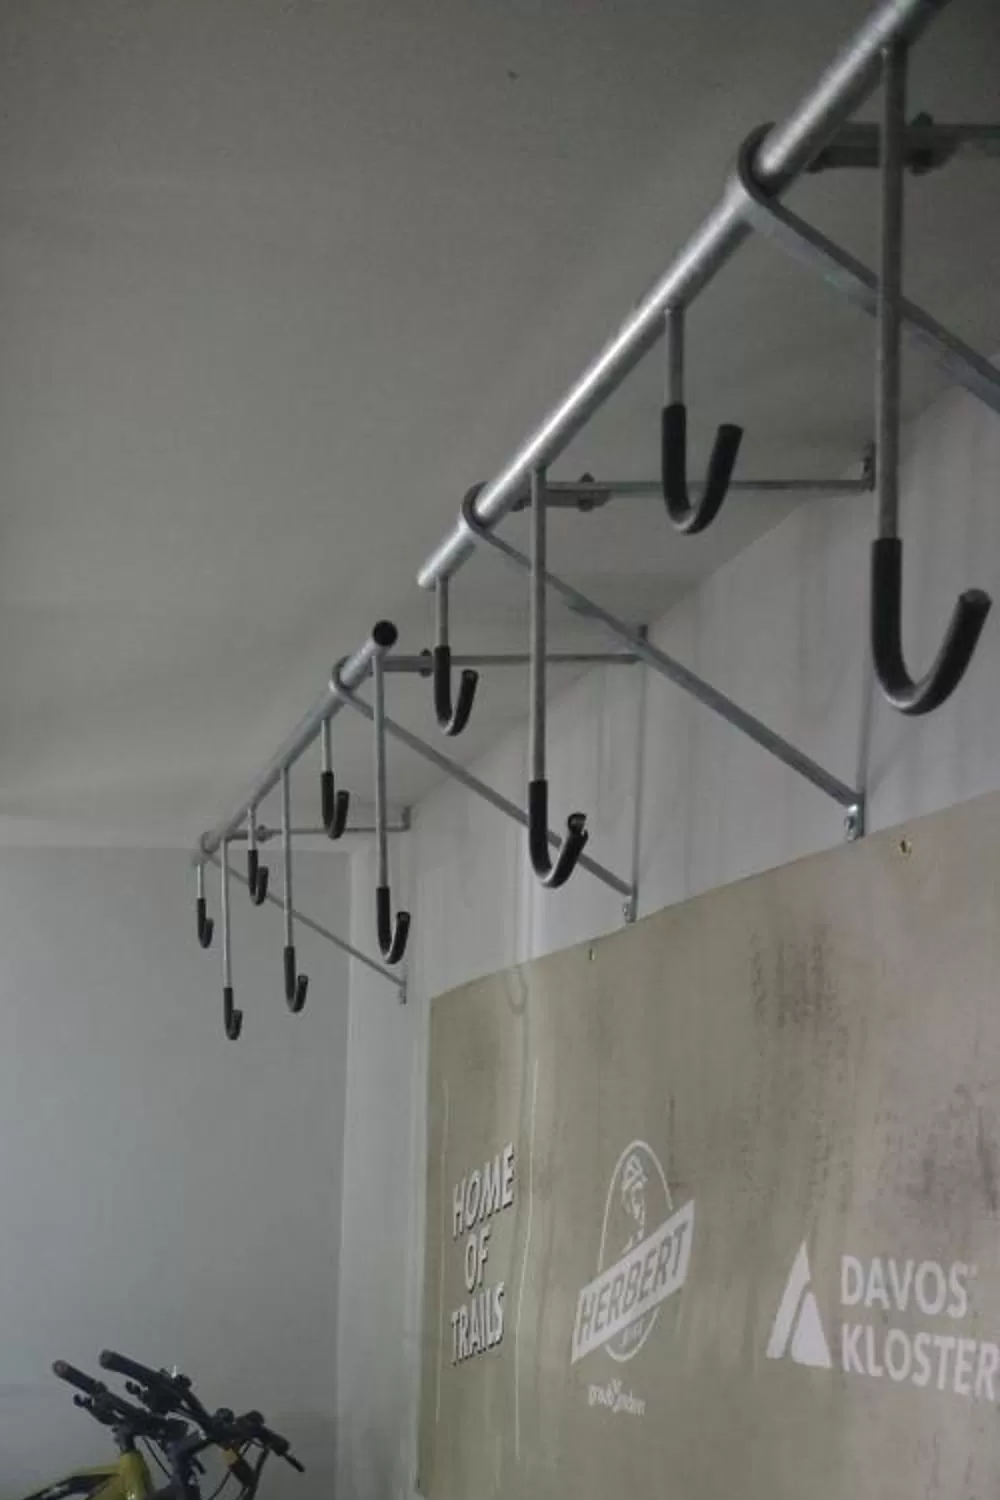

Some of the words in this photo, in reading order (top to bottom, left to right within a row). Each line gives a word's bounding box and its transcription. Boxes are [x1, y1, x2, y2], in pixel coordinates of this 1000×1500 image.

[452, 1142, 514, 1242] HOME
[465, 1223, 491, 1294] OF
[577, 1222, 688, 1346] HERBERT
[840, 1254, 968, 1320] DAVOS
[451, 1281, 505, 1367] TRAILS
[841, 1323, 1000, 1402] KLOSTER
